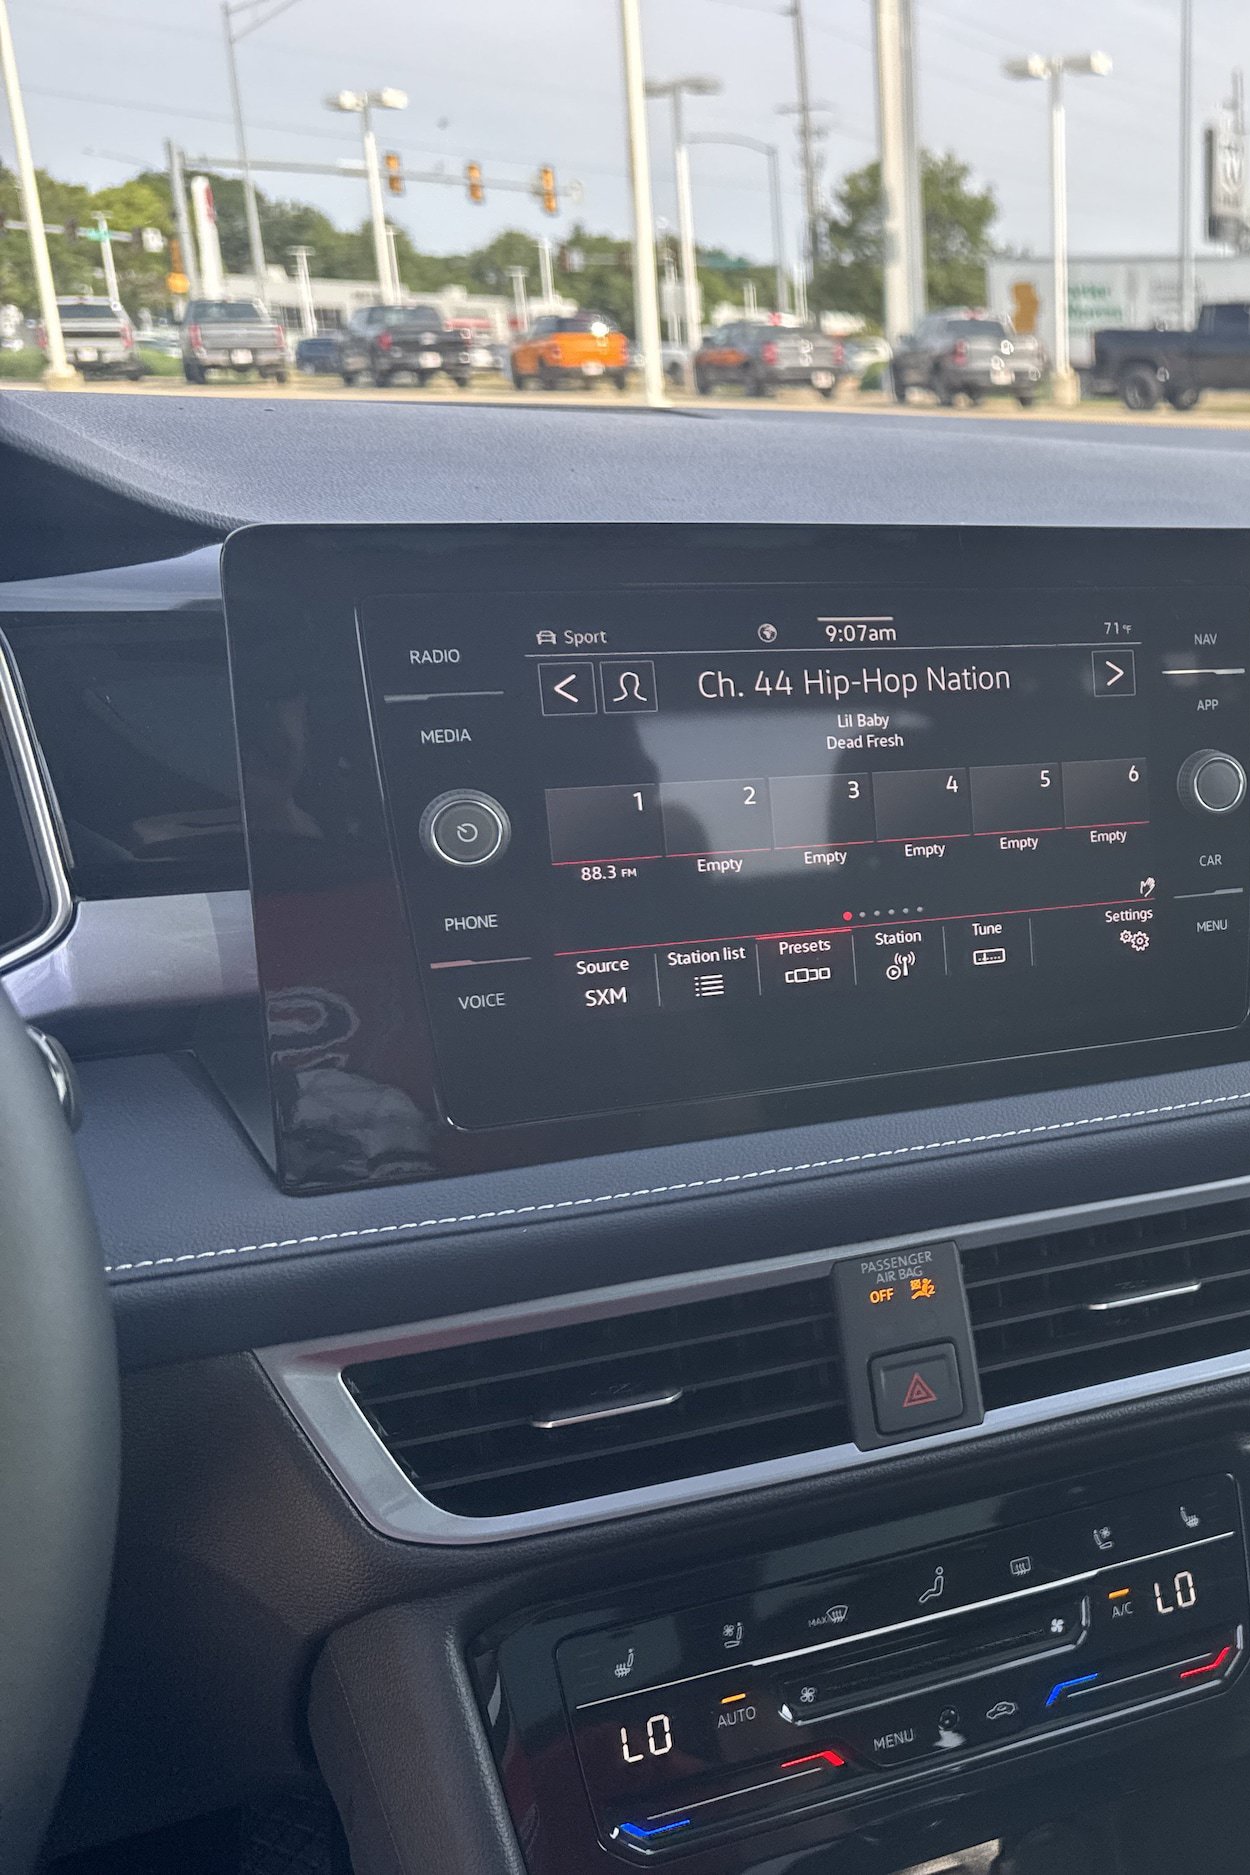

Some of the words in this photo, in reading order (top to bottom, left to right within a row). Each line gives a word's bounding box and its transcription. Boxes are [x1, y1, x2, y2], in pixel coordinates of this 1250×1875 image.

[564, 630, 607, 645] Sport
[825, 625, 896, 643] 9:07am
[1194, 634, 1218, 645] NAV
[409, 649, 460, 664] RADIO
[698, 670, 743, 698] Ch.
[754, 670, 793, 696] 44
[803, 668, 918, 699] Hip-Hop
[927, 666, 1011, 690] Nation
[1197, 700, 1218, 711] APP
[838, 714, 853, 727] Lil
[857, 713, 890, 730] Baby
[421, 728, 472, 744] MEDIA
[827, 736, 862, 749] Dead
[867, 733, 904, 748] Fresh
[1040, 771, 1050, 788] 5
[1128, 765, 1139, 782] 6
[848, 781, 860, 799] 3
[946, 776, 958, 793] 4
[633, 792, 644, 811] 1
[743, 787, 756, 805] 2
[1000, 836, 1038, 852] Empty
[1090, 829, 1127, 845] Empty
[804, 850, 847, 866] Empty
[905, 842, 945, 859] Empty
[697, 858, 743, 874] Empty
[1199, 855, 1222, 867] CAR
[580, 866, 617, 881] 88.3
[621, 868, 637, 878] FM
[444, 914, 498, 931] PHONE
[1105, 908, 1153, 923] Settings
[972, 922, 1002, 936] Tune
[1196, 919, 1228, 933] MENU
[875, 929, 922, 946] Station
[779, 939, 831, 956] Presets
[668, 949, 719, 967] Station
[723, 946, 746, 962] list
[577, 957, 629, 975] Source
[458, 993, 506, 1010] VOICE
[585, 988, 627, 1007] SXM
[861, 1251, 932, 1274] PASSENGER
[876, 1272, 896, 1284] AIR
[899, 1266, 923, 1279] BAG
[870, 1288, 894, 1304] OFF
[1112, 1602, 1133, 1618] A/C
[808, 1617, 827, 1628] MAX
[717, 1707, 756, 1728] AUTO
[873, 1729, 914, 1750] MENU
